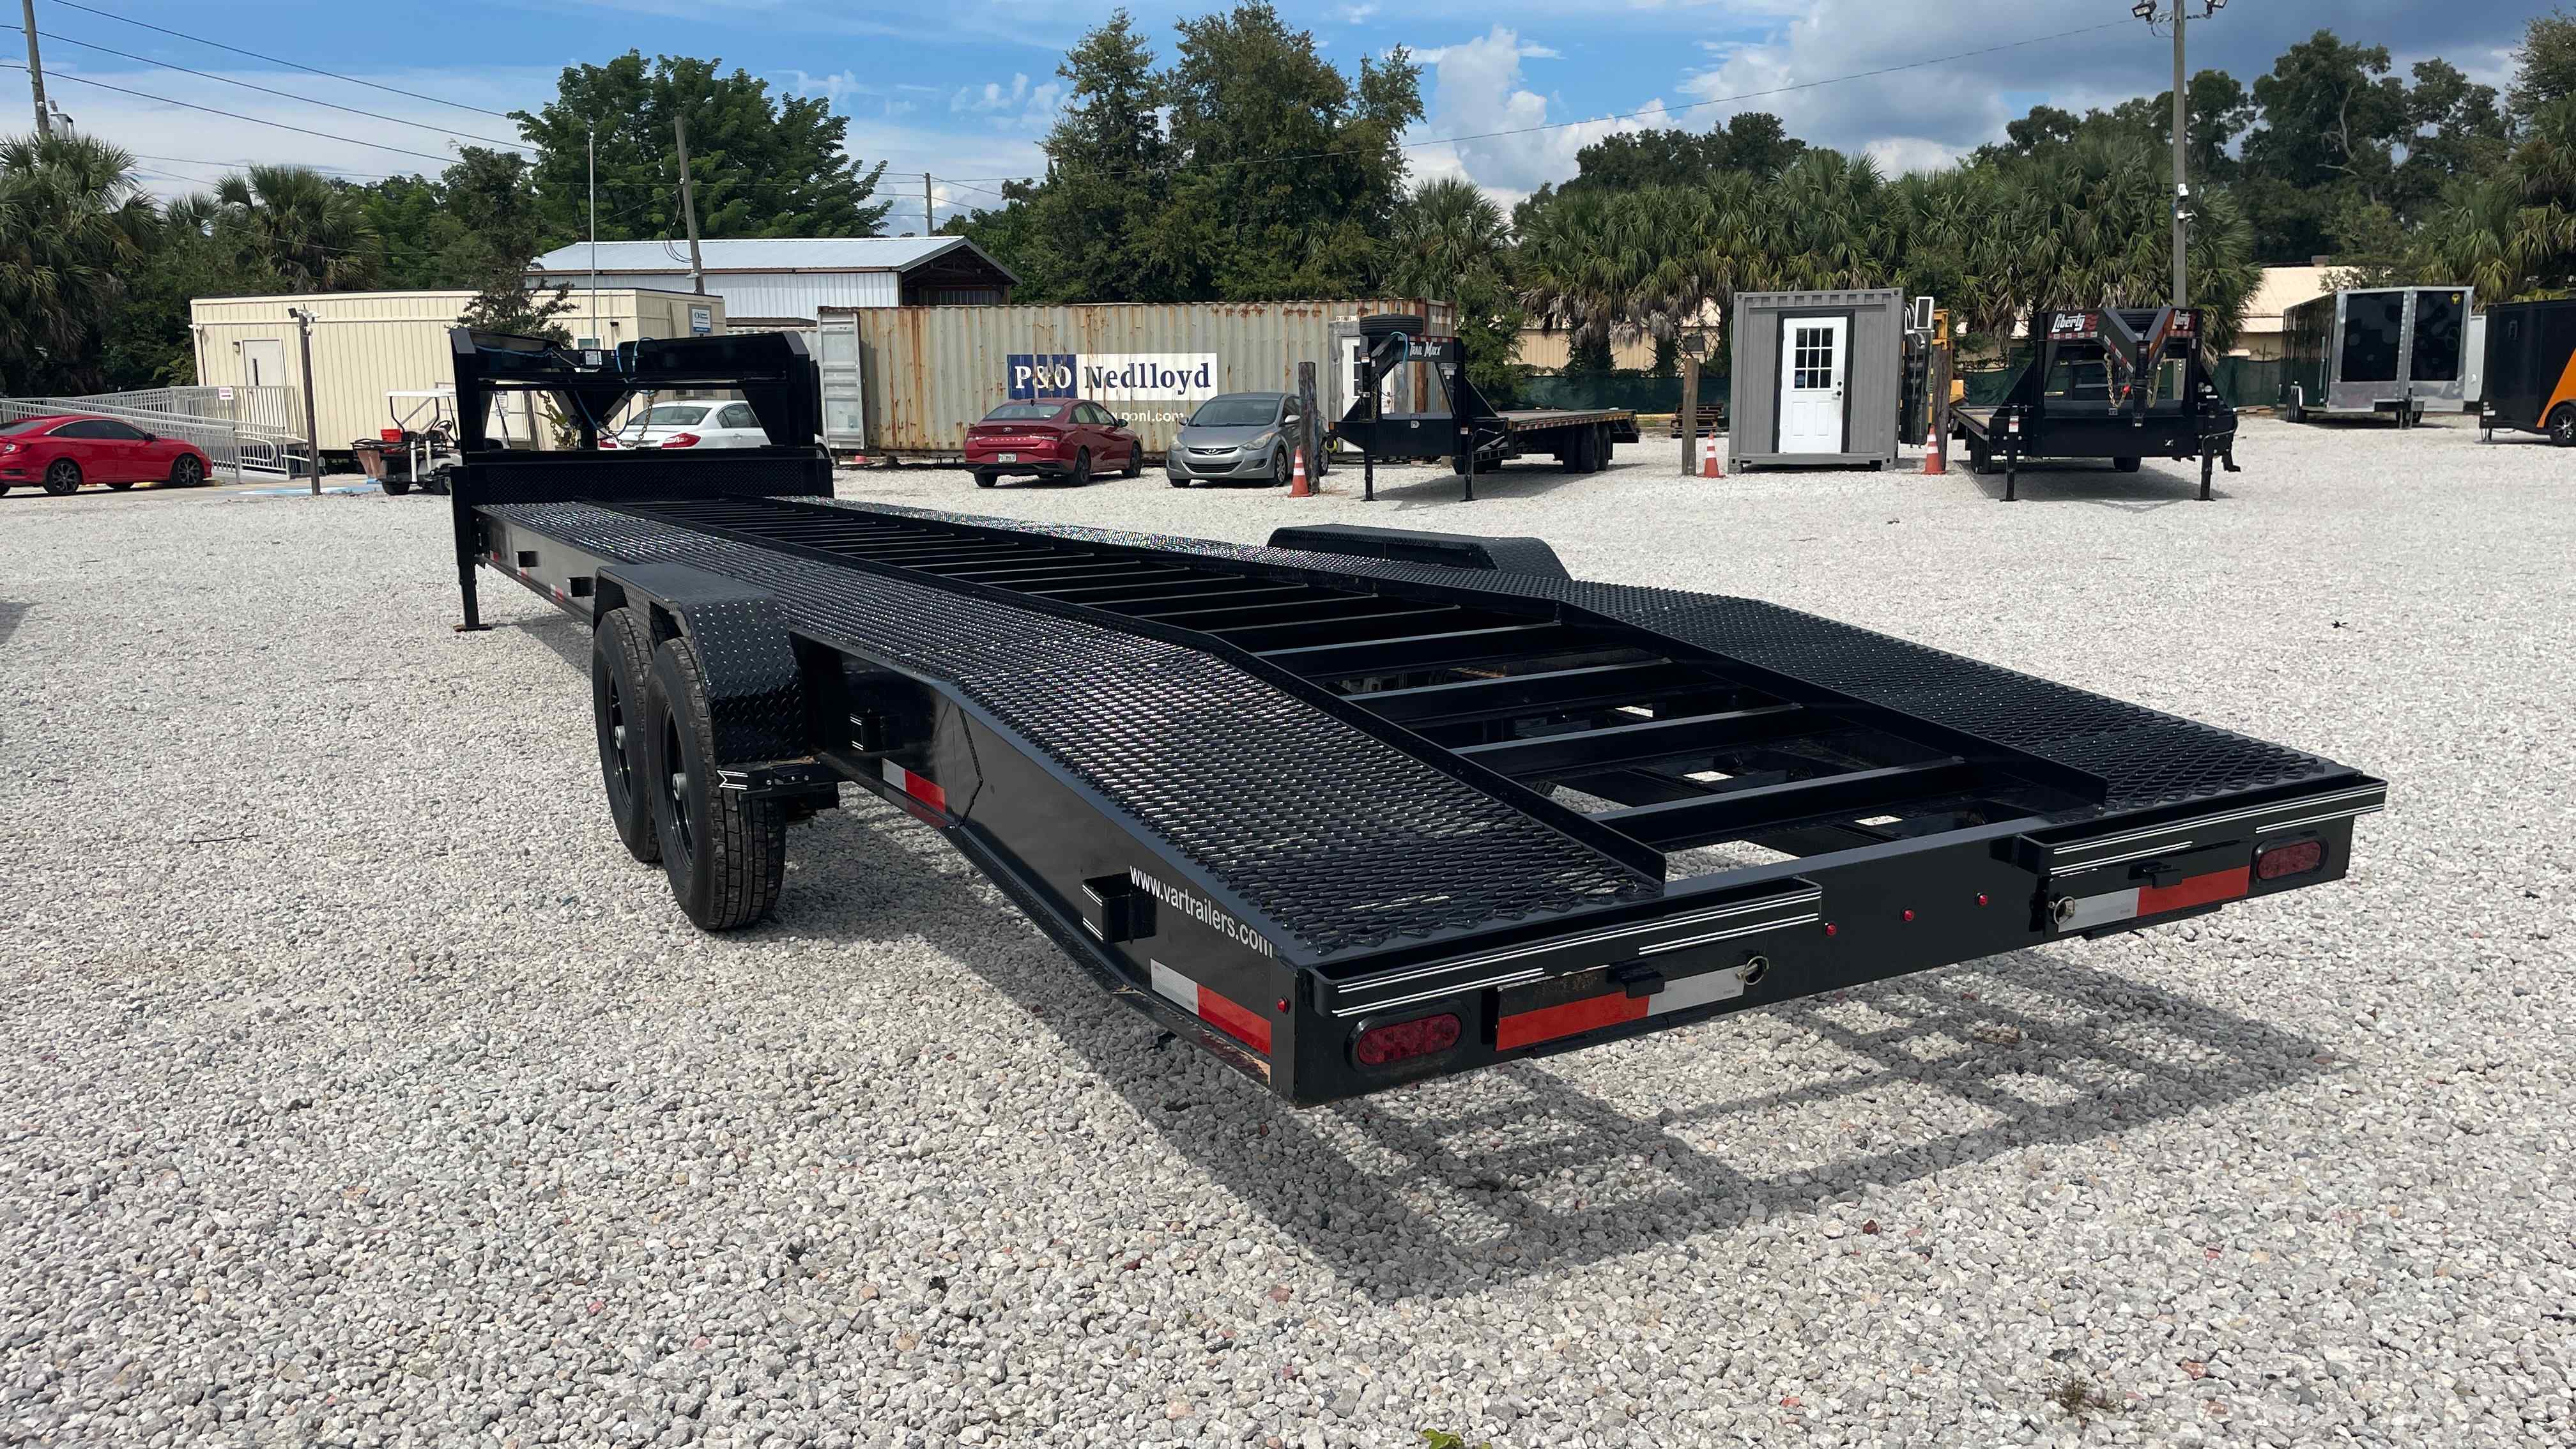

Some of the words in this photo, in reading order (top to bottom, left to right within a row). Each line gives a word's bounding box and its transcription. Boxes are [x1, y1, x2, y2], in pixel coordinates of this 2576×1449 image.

[2051, 312, 2085, 332] Liberty
[1015, 365, 1071, 389] P&O
[1084, 362, 1211, 395] Nedlloyd
[1130, 865, 1273, 958] www.vartrailers.com
